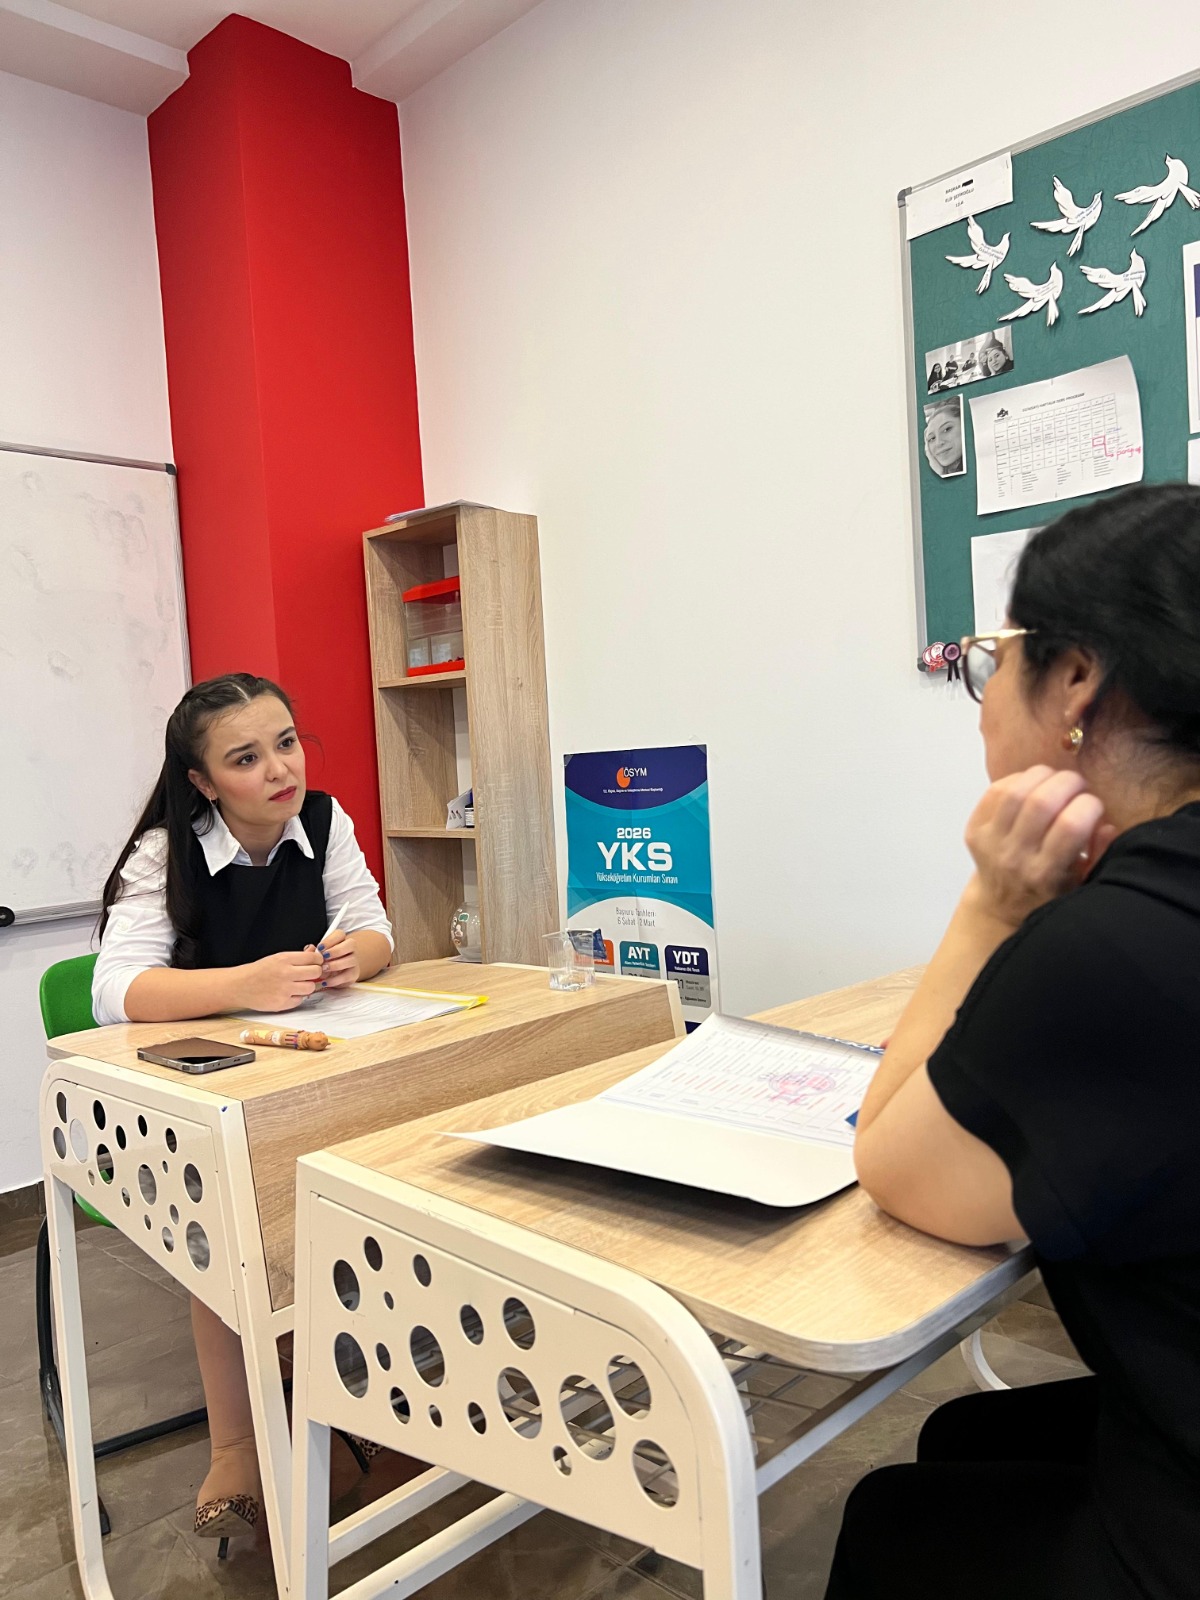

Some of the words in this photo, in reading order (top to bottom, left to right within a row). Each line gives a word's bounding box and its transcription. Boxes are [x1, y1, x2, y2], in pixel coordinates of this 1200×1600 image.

[624, 767, 647, 777] ÖSYM
[616, 827, 651, 839] 2026
[597, 842, 673, 871] YKS
[628, 946, 650, 960] AYT
[673, 950, 699, 965] YDT
